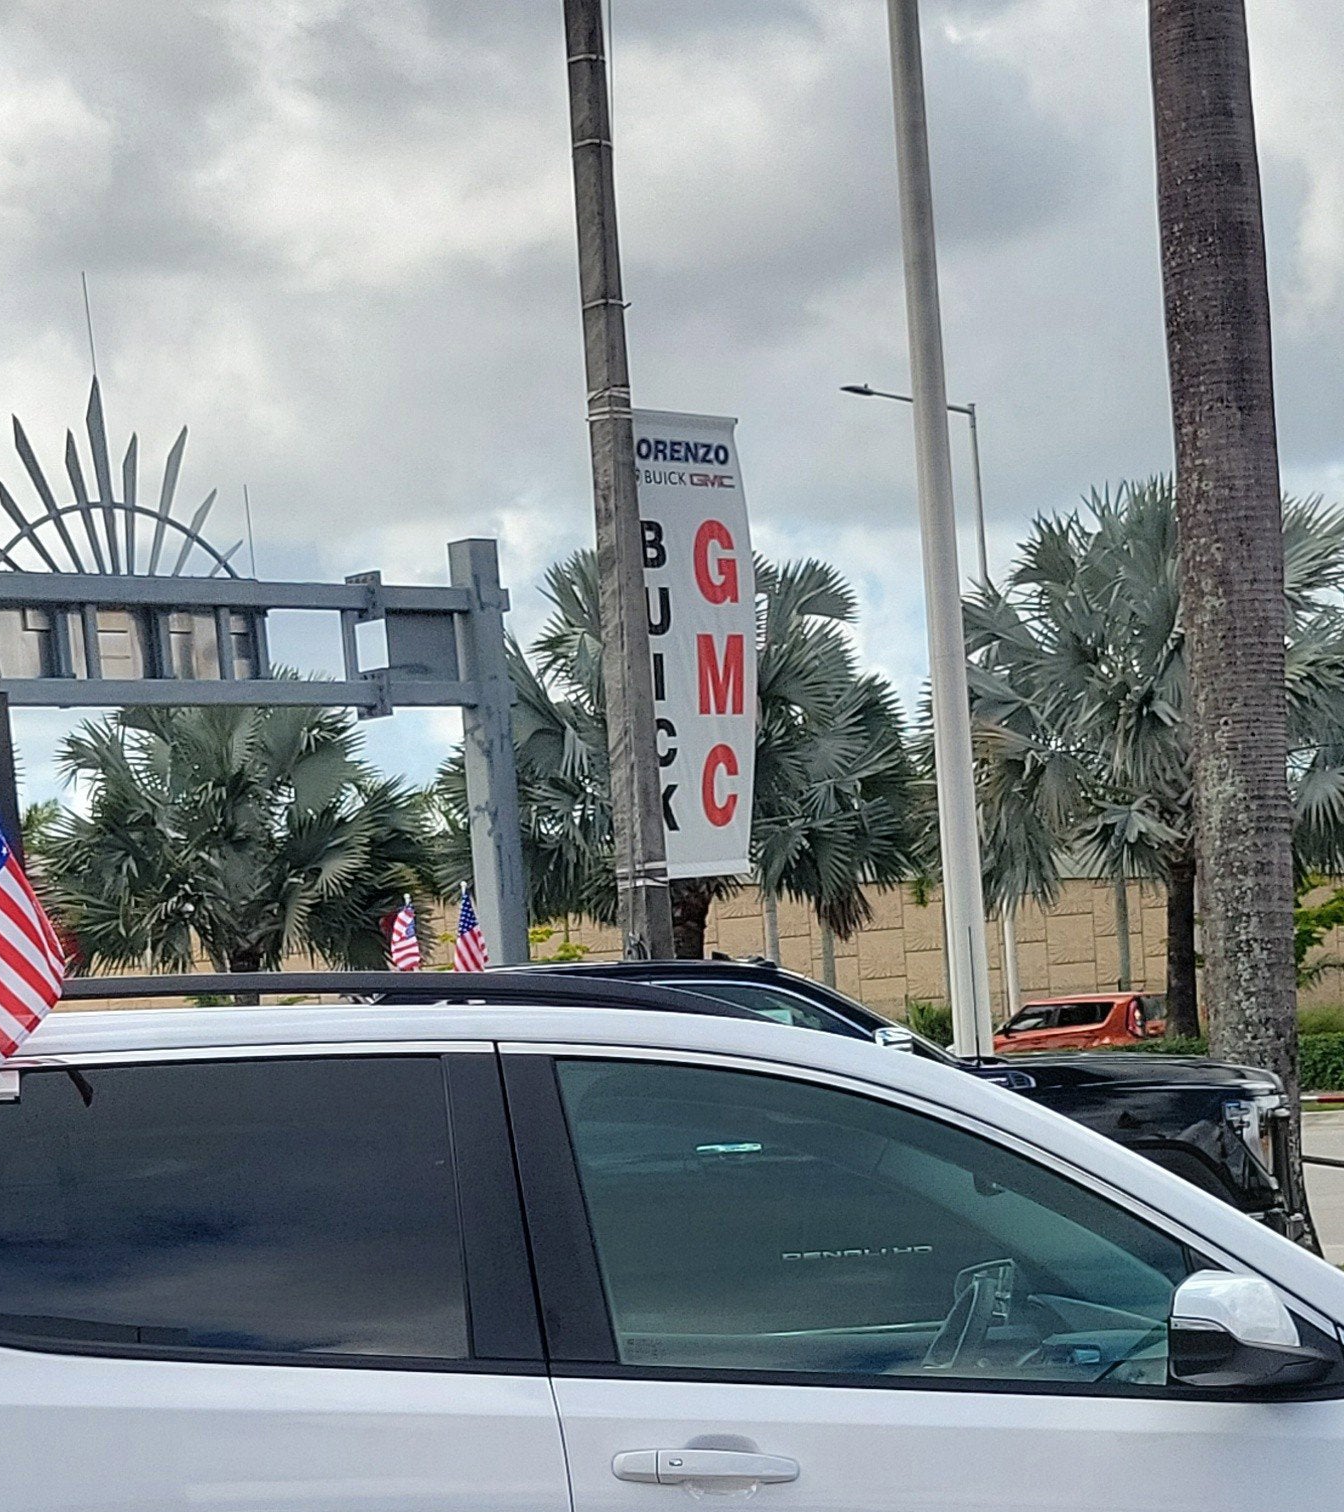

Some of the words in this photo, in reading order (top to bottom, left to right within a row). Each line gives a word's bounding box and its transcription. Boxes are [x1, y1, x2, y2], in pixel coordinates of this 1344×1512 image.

[636, 437, 730, 466] ORENZO
[644, 470, 687, 486] BUICK
[689, 473, 736, 489] GMC
[693, 519, 745, 827] GMC
